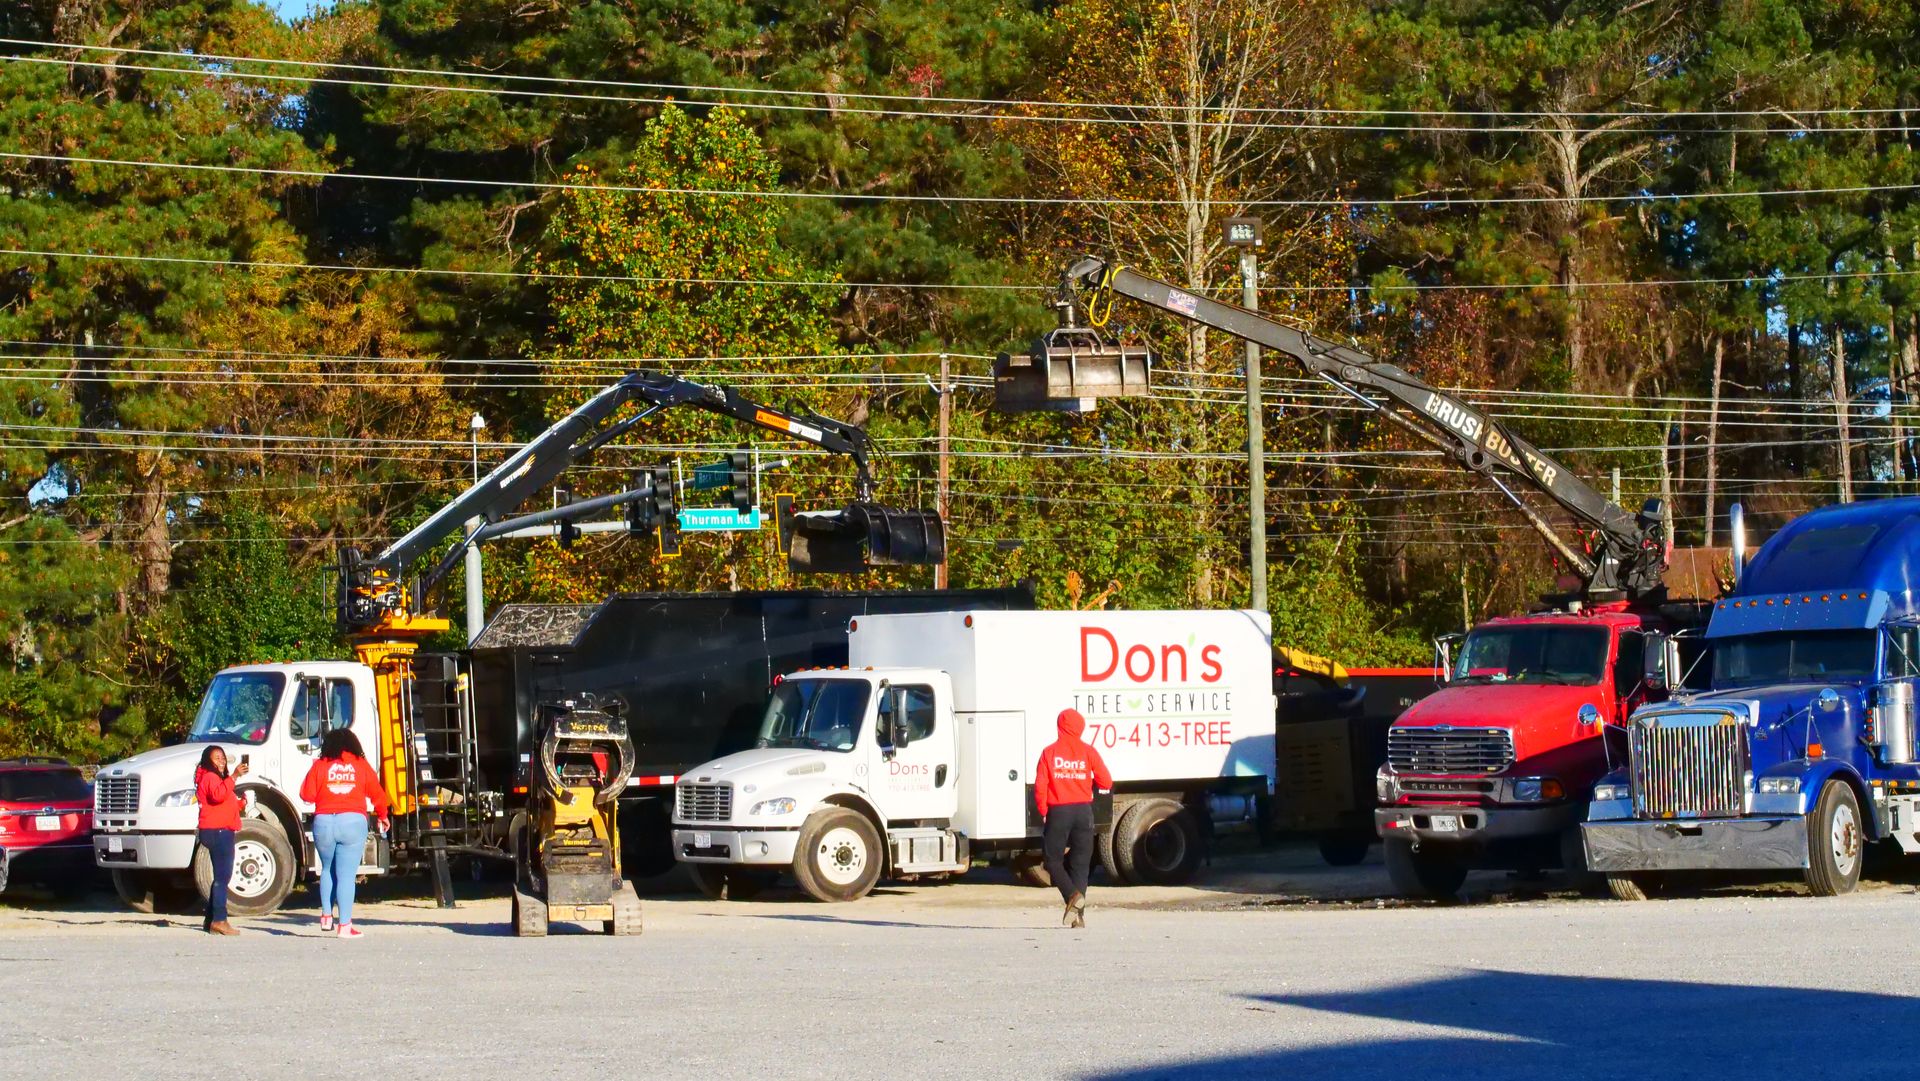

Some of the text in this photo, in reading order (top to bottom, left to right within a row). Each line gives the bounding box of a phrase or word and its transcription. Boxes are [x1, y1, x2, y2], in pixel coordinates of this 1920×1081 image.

[685, 514, 733, 525] Thurman
[1080, 626, 1223, 683] Don's
[1074, 692, 1231, 713] TREE SERVICE
[1089, 721, 1232, 748] 70-413-TREE
[890, 761, 929, 776] Dons
[1054, 756, 1086, 769] Don's
[1411, 783, 1462, 791] STERLI
